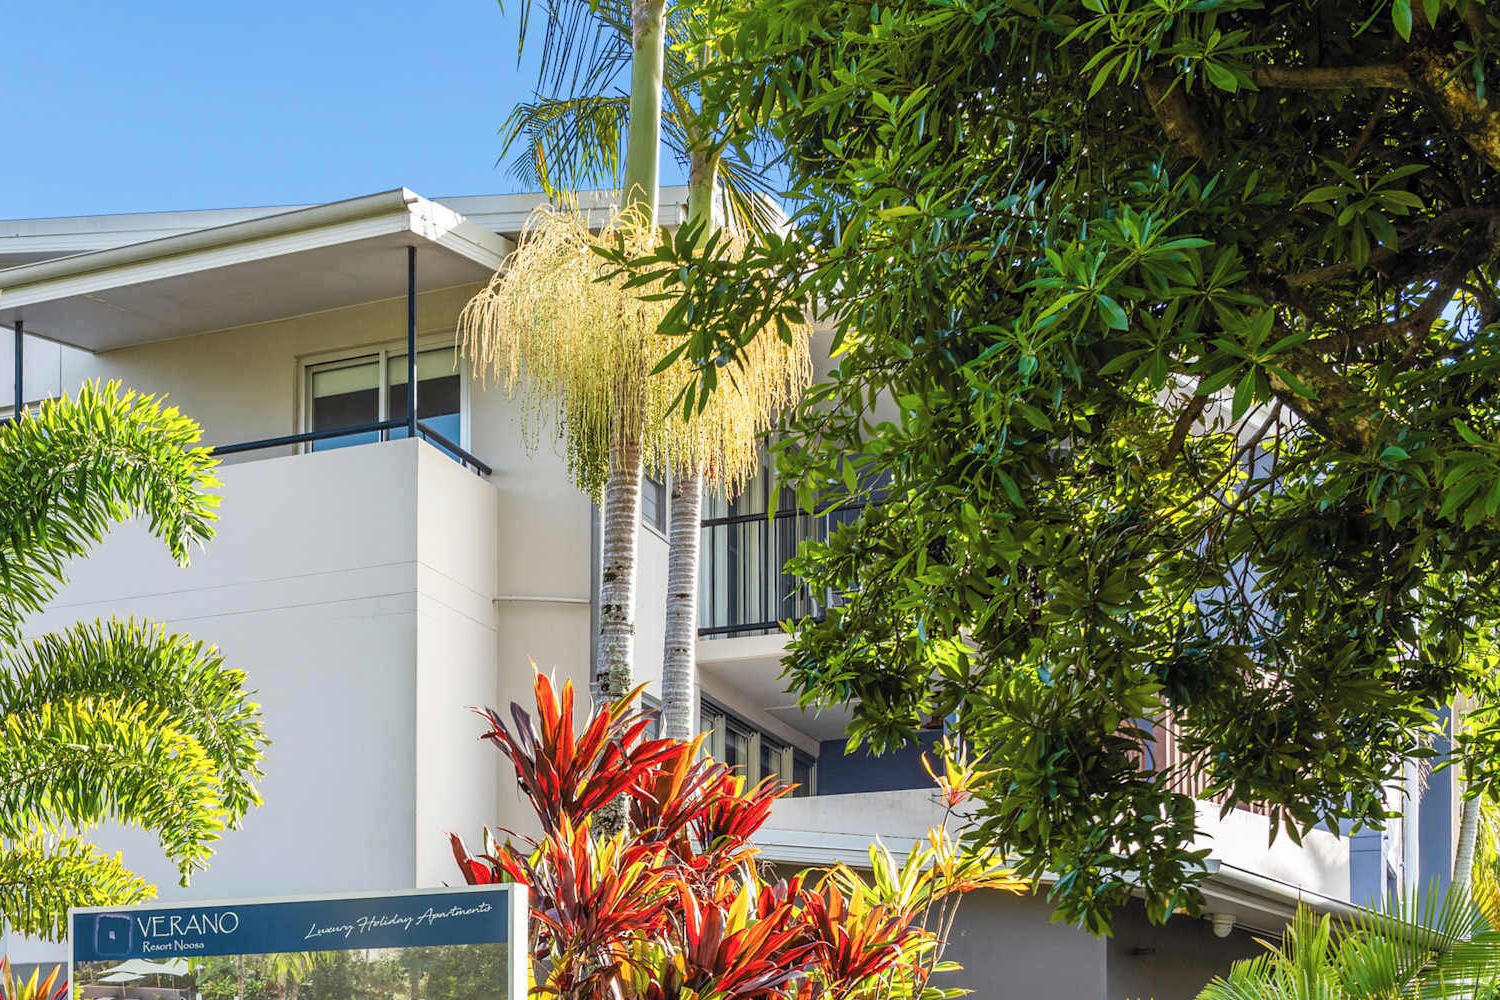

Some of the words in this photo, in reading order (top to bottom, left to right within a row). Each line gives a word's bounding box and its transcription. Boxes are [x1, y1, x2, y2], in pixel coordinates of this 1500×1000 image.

[137, 911, 239, 938] VERANO
[304, 923, 355, 939] Luxury
[356, 914, 414, 932] Holiday
[416, 902, 492, 926] Apartments
[143, 941, 172, 953] Resort
[174, 940, 205, 951] Noosa
